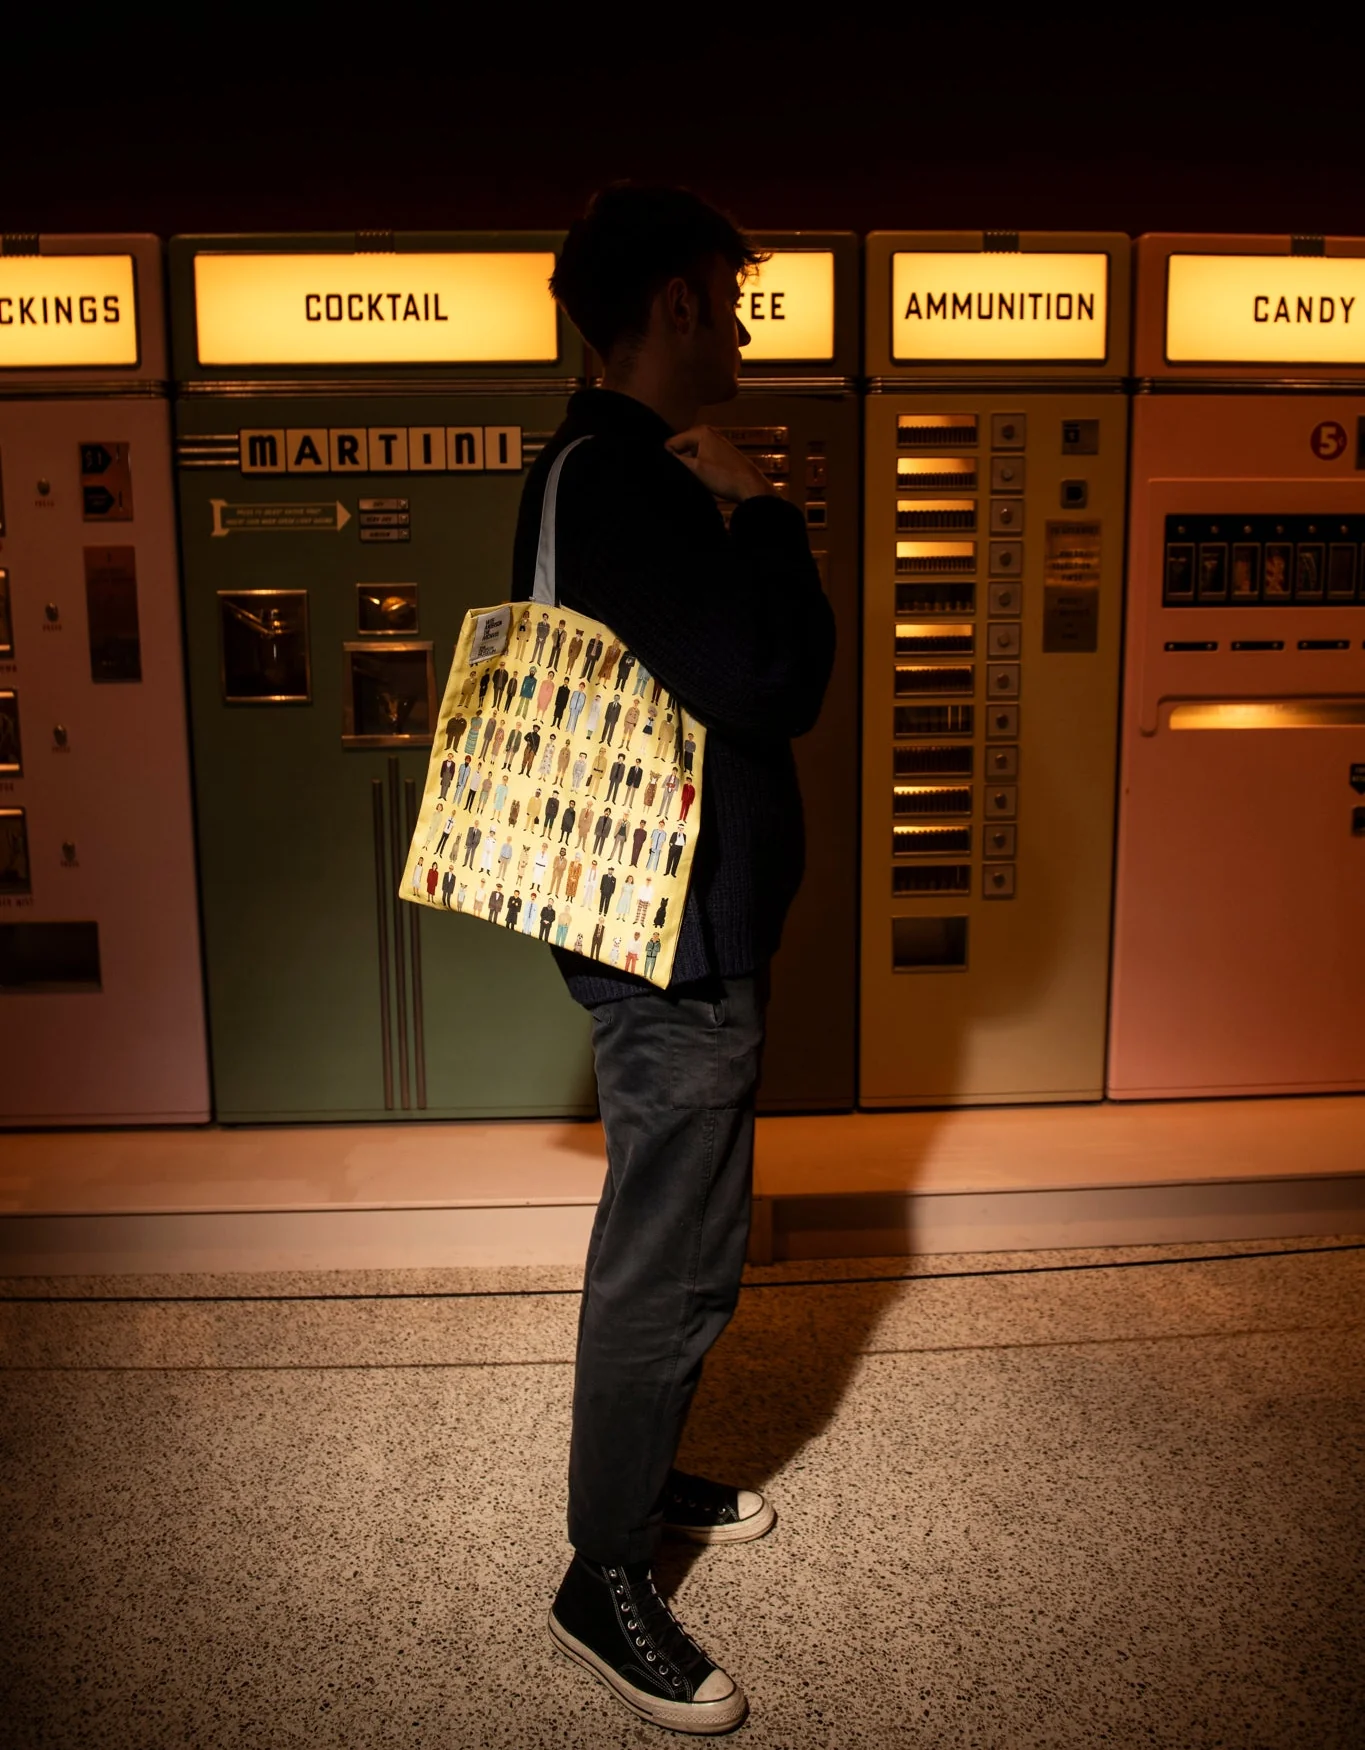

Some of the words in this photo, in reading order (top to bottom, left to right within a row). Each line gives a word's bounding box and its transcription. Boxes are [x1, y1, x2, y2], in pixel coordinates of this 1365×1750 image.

[0, 296, 120, 324] CKINGS
[305, 293, 448, 321] COCKTAIL
[736, 292, 785, 320] EE
[905, 292, 1095, 320] AMMUNITION
[1253, 295, 1356, 324] CANDY
[248, 432, 508, 467] MARTINI
